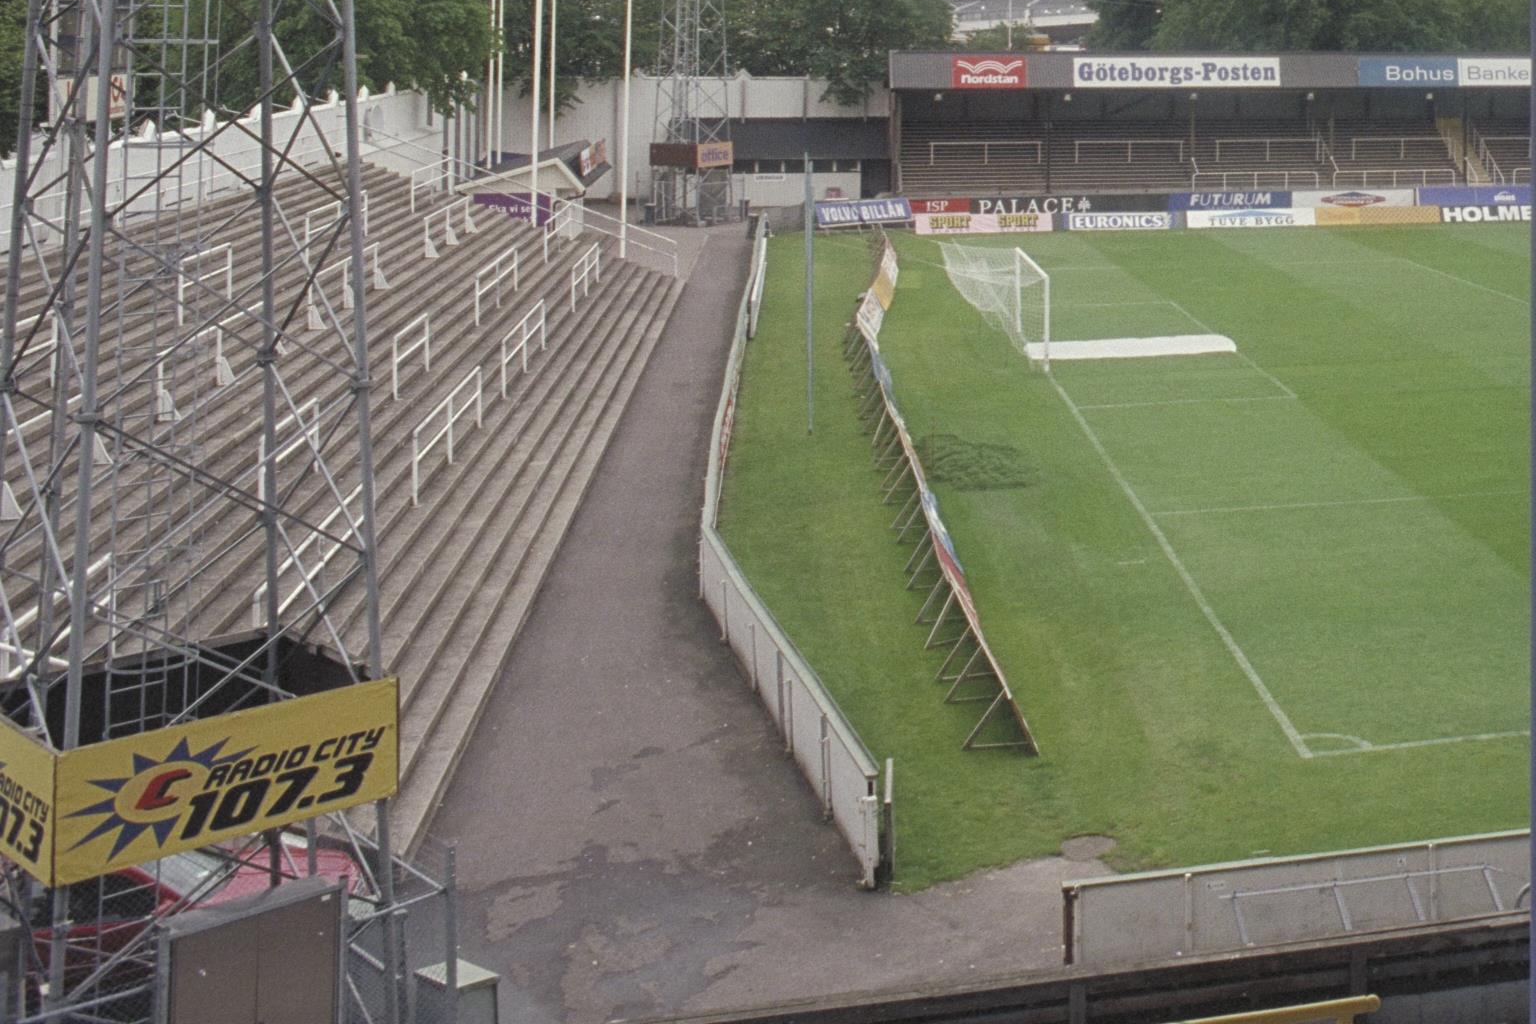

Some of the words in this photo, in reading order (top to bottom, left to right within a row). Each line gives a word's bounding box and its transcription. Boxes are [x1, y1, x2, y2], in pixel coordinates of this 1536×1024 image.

[1078, 62, 1276, 84] Göteborgs-Posten
[1386, 66, 1454, 81] Bohus
[926, 200, 949, 212] ISP
[979, 197, 1075, 215] PALACE
[1190, 193, 1272, 207] FUTURUM
[929, 216, 971, 229] SPORT
[998, 215, 1039, 228] SPORT
[1075, 215, 1163, 228] EURONICS
[1208, 216, 1248, 226] TUVE
[1255, 215, 1294, 226] BYGG
[203, 744, 311, 791] RADIO
[312, 726, 386, 763] CITY
[180, 751, 375, 841] 107.3
[23, 791, 50, 823] CITY
